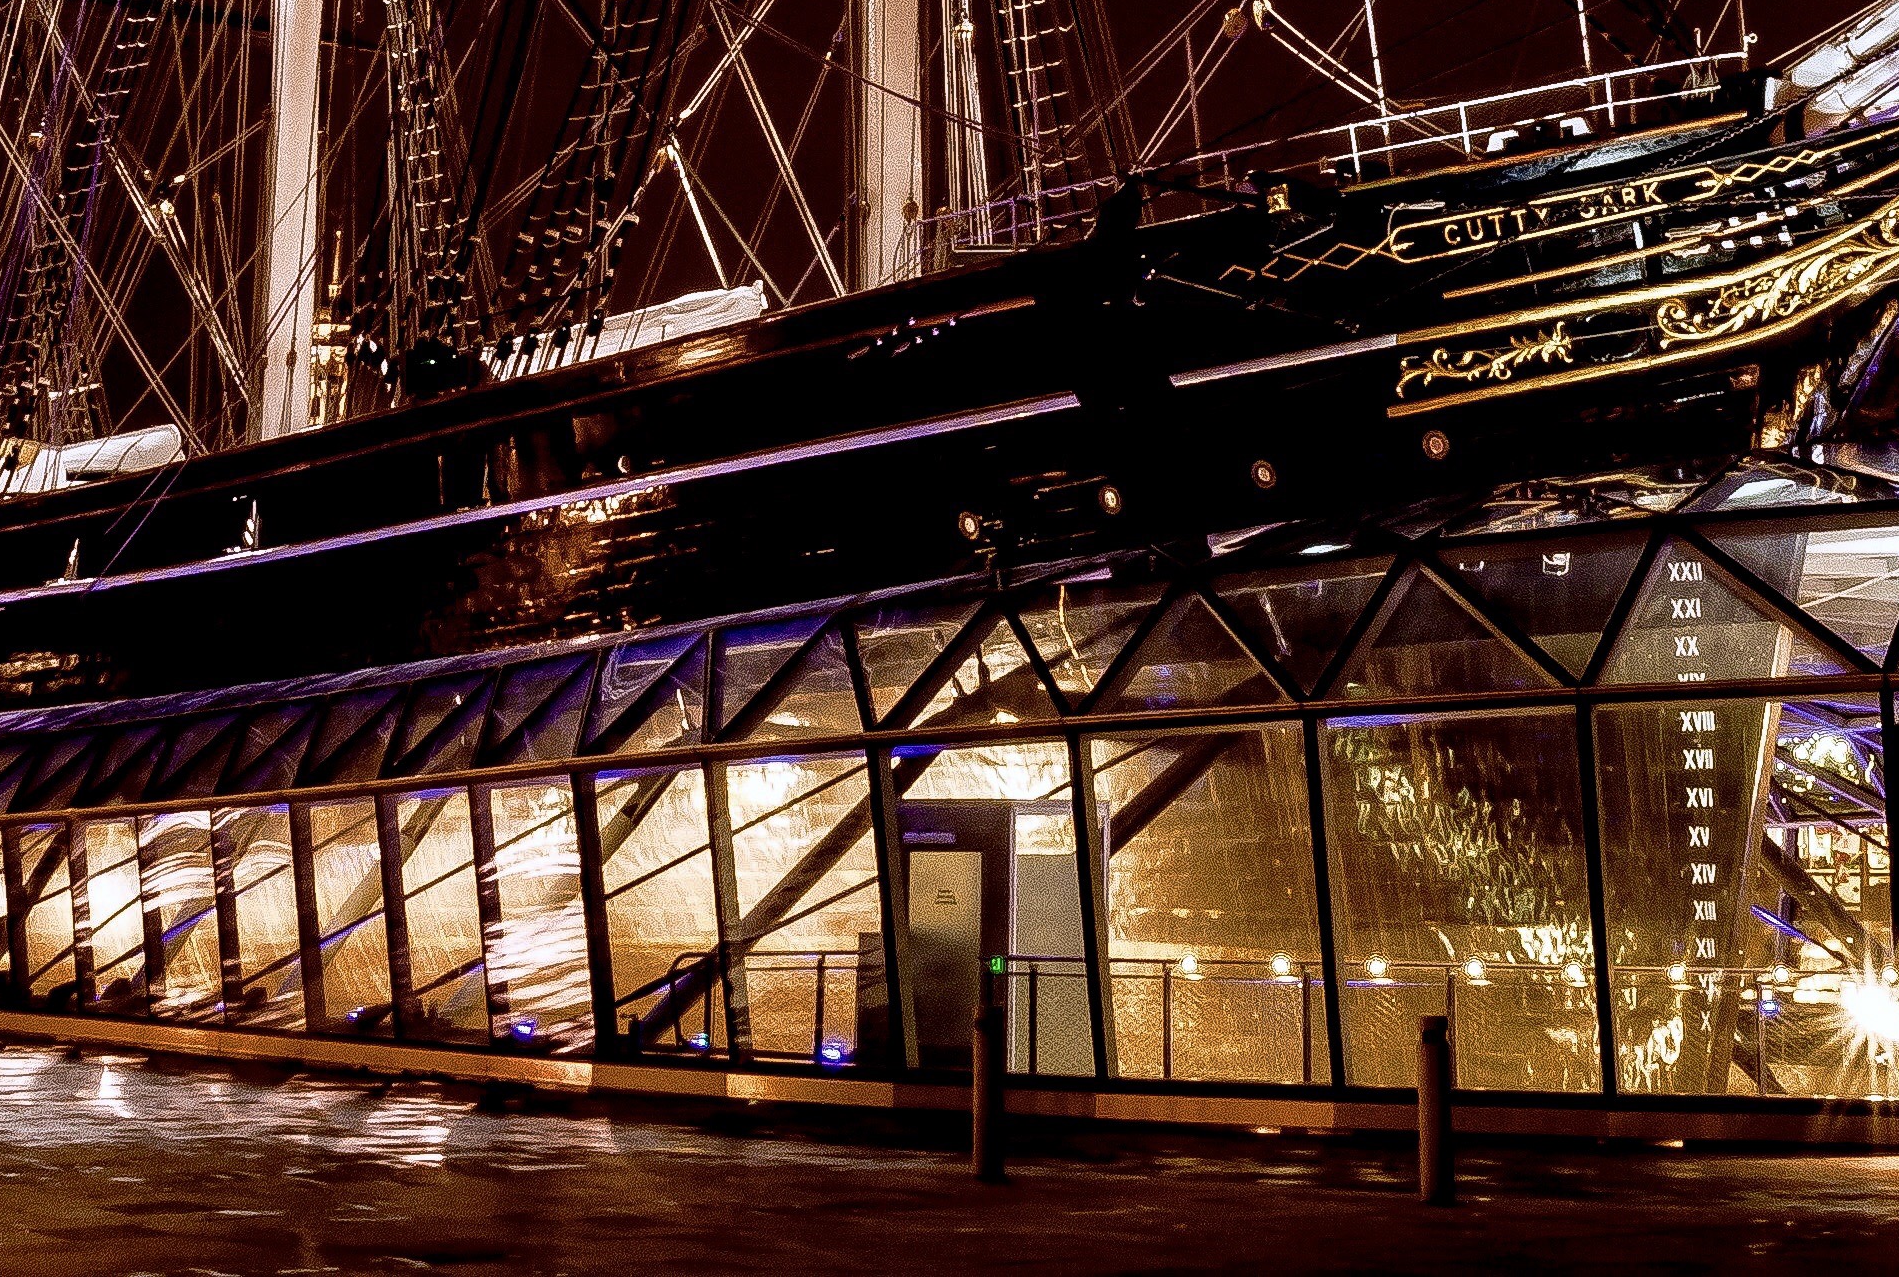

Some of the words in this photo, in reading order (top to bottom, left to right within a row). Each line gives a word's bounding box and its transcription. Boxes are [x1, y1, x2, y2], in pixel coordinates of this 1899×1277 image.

[1444, 207, 1549, 245] CUTTY
[1580, 182, 1662, 219] SARK
[1668, 561, 1702, 581] XXII
[1671, 598, 1701, 618] XXI
[1674, 636, 1699, 656] XX
[1680, 711, 1715, 732] XVIII
[1683, 749, 1714, 769] XVII
[1686, 787, 1713, 807] XVI
[1689, 826, 1710, 846] XV
[1691, 863, 1716, 884] XIV
[1694, 900, 1716, 920] XIII
[1696, 938, 1715, 958] XII
[1701, 1011, 1711, 1031] X
